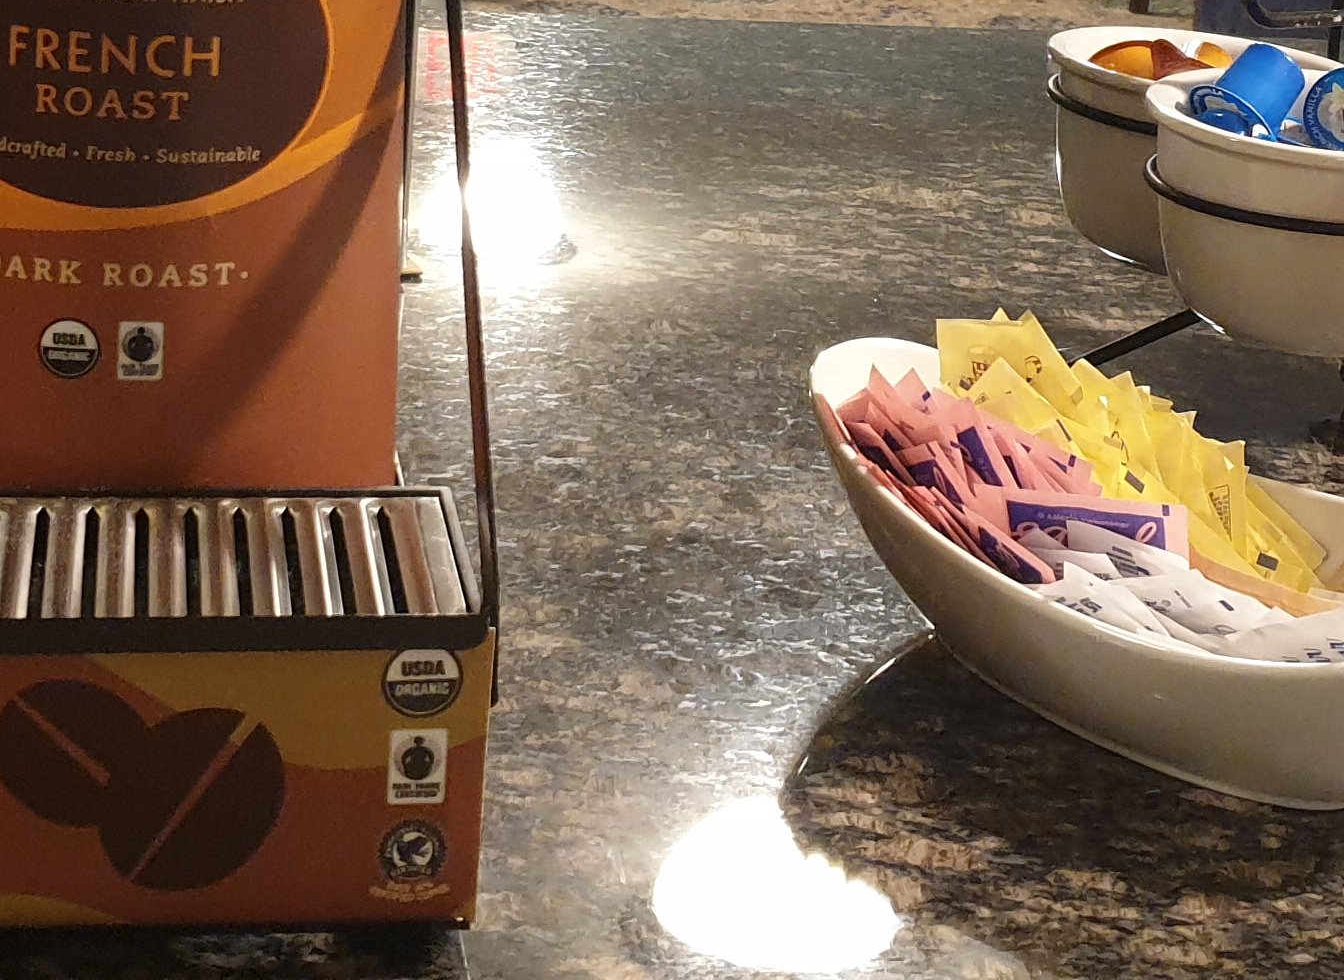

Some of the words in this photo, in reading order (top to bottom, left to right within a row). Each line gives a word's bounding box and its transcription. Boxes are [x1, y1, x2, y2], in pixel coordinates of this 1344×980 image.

[8, 24, 222, 78] FRENCH
[35, 83, 190, 122] ROAST
[86, 144, 136, 164] Fresh
[156, 145, 262, 165] Sustainable
[103, 261, 235, 288] ROAST
[53, 333, 87, 346] USDA
[401, 660, 446, 677] USDA
[393, 681, 450, 697] ORGANIC
